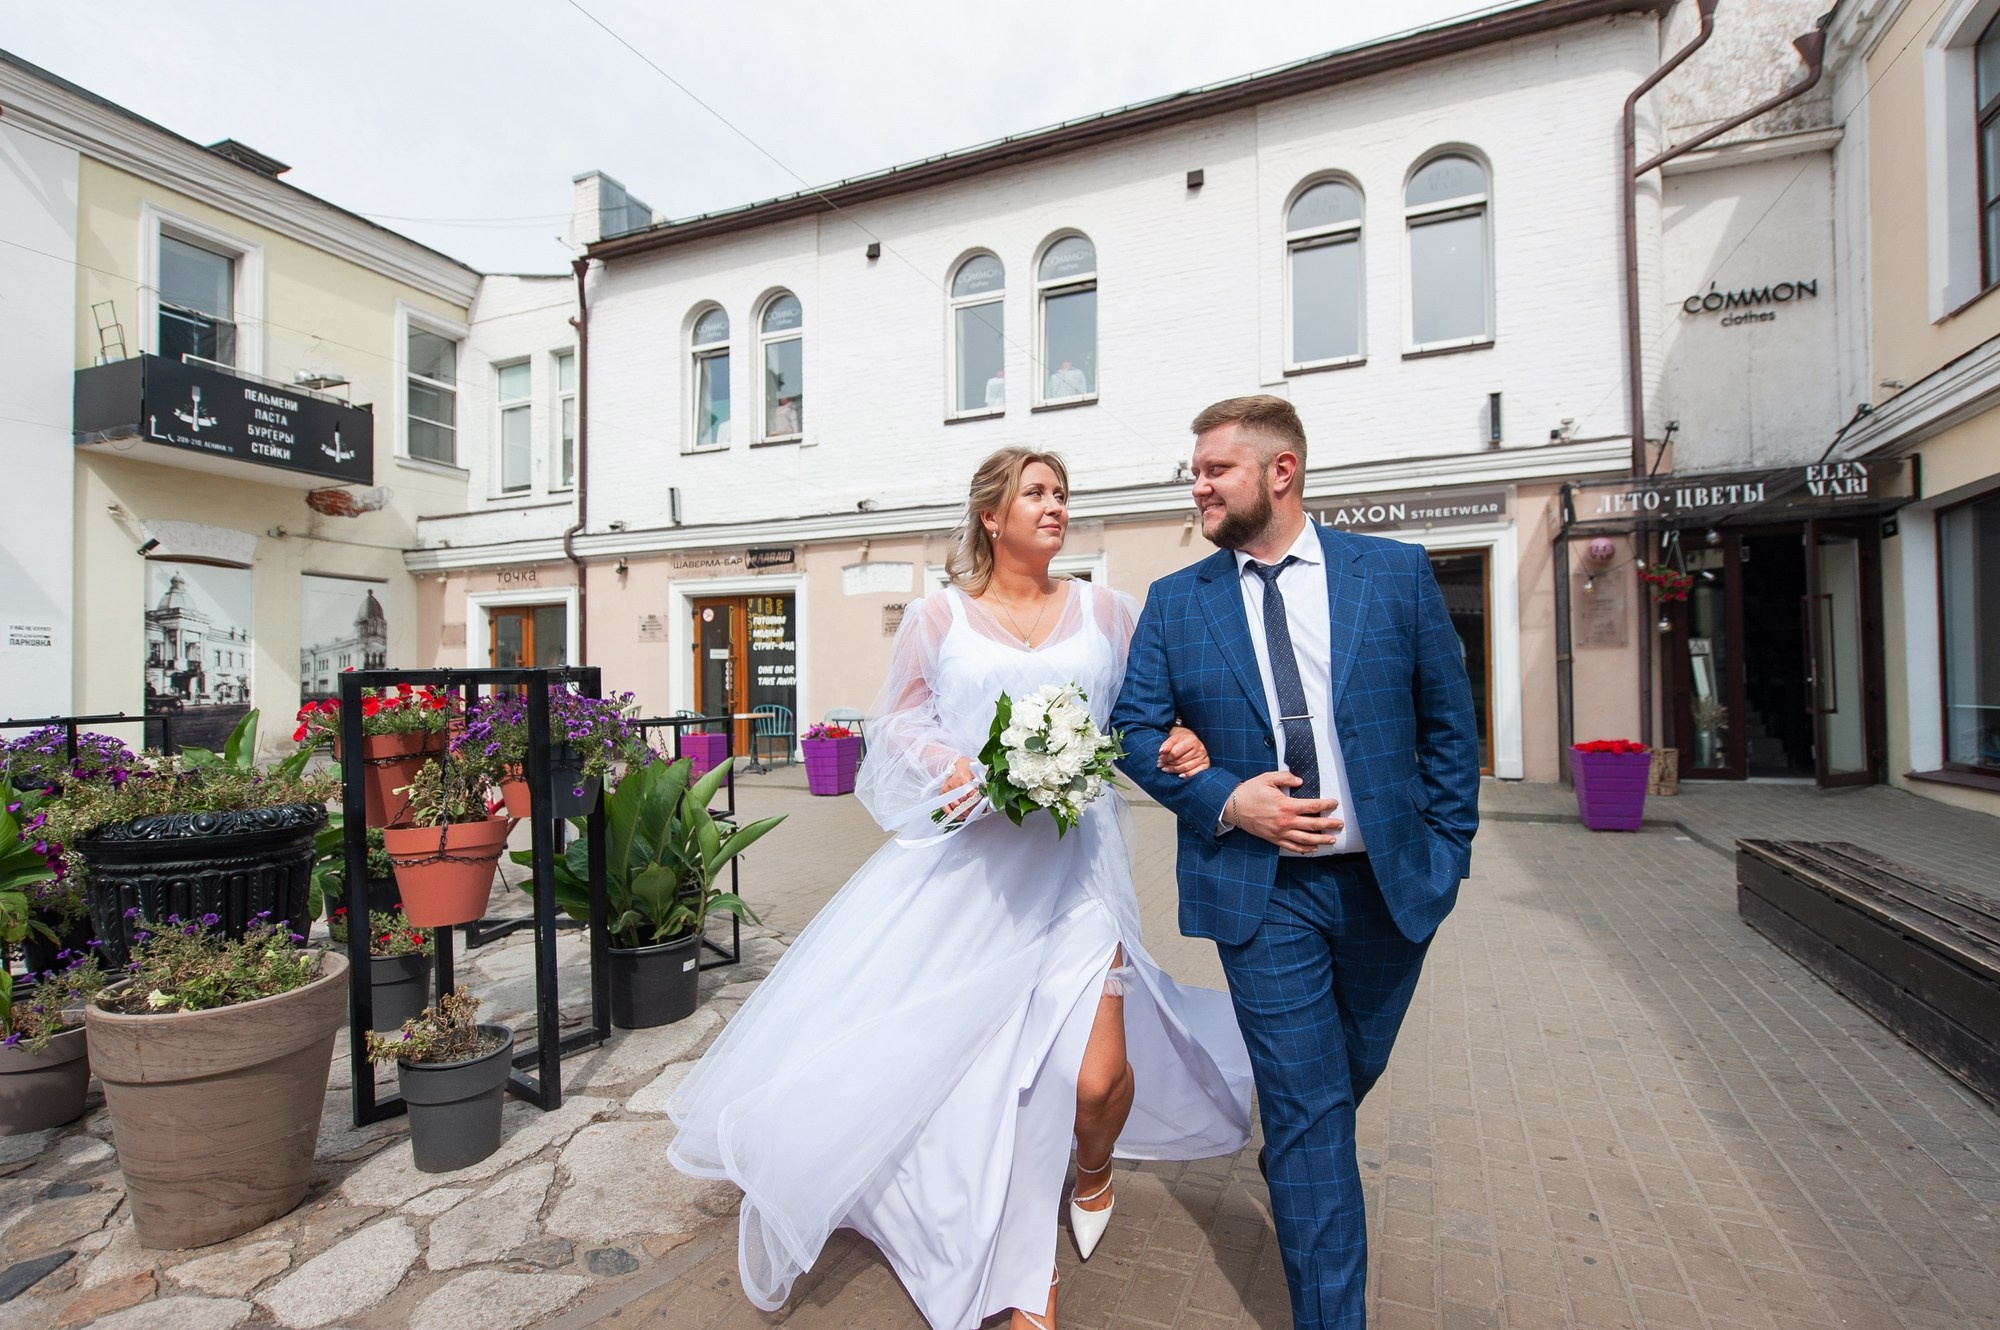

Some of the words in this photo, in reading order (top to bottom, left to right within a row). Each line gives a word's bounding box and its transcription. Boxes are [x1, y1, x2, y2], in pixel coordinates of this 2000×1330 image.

[1721, 310, 1777, 327] clothes
[244, 388, 299, 412] ПЕЛЬМЕНИ
[254, 408, 288, 426] ПАСТА
[247, 424, 295, 444] БУРГЕРЫ
[251, 441, 291, 460] СТЕЙКИ
[1806, 462, 1868, 481] ELEN
[1807, 477, 1868, 496] MARI
[1410, 503, 1498, 520] STREETWEAR
[672, 557, 743, 570] ШАВЕРМА-БАР
[496, 570, 536, 583] точка
[10, 638, 52, 647] ПАРКОВКА
[752, 641, 795, 651] СТРИТ-ФУД
[774, 665, 784, 674] IN
[784, 664, 795, 674] OR
[757, 677, 776, 686] TAKE
